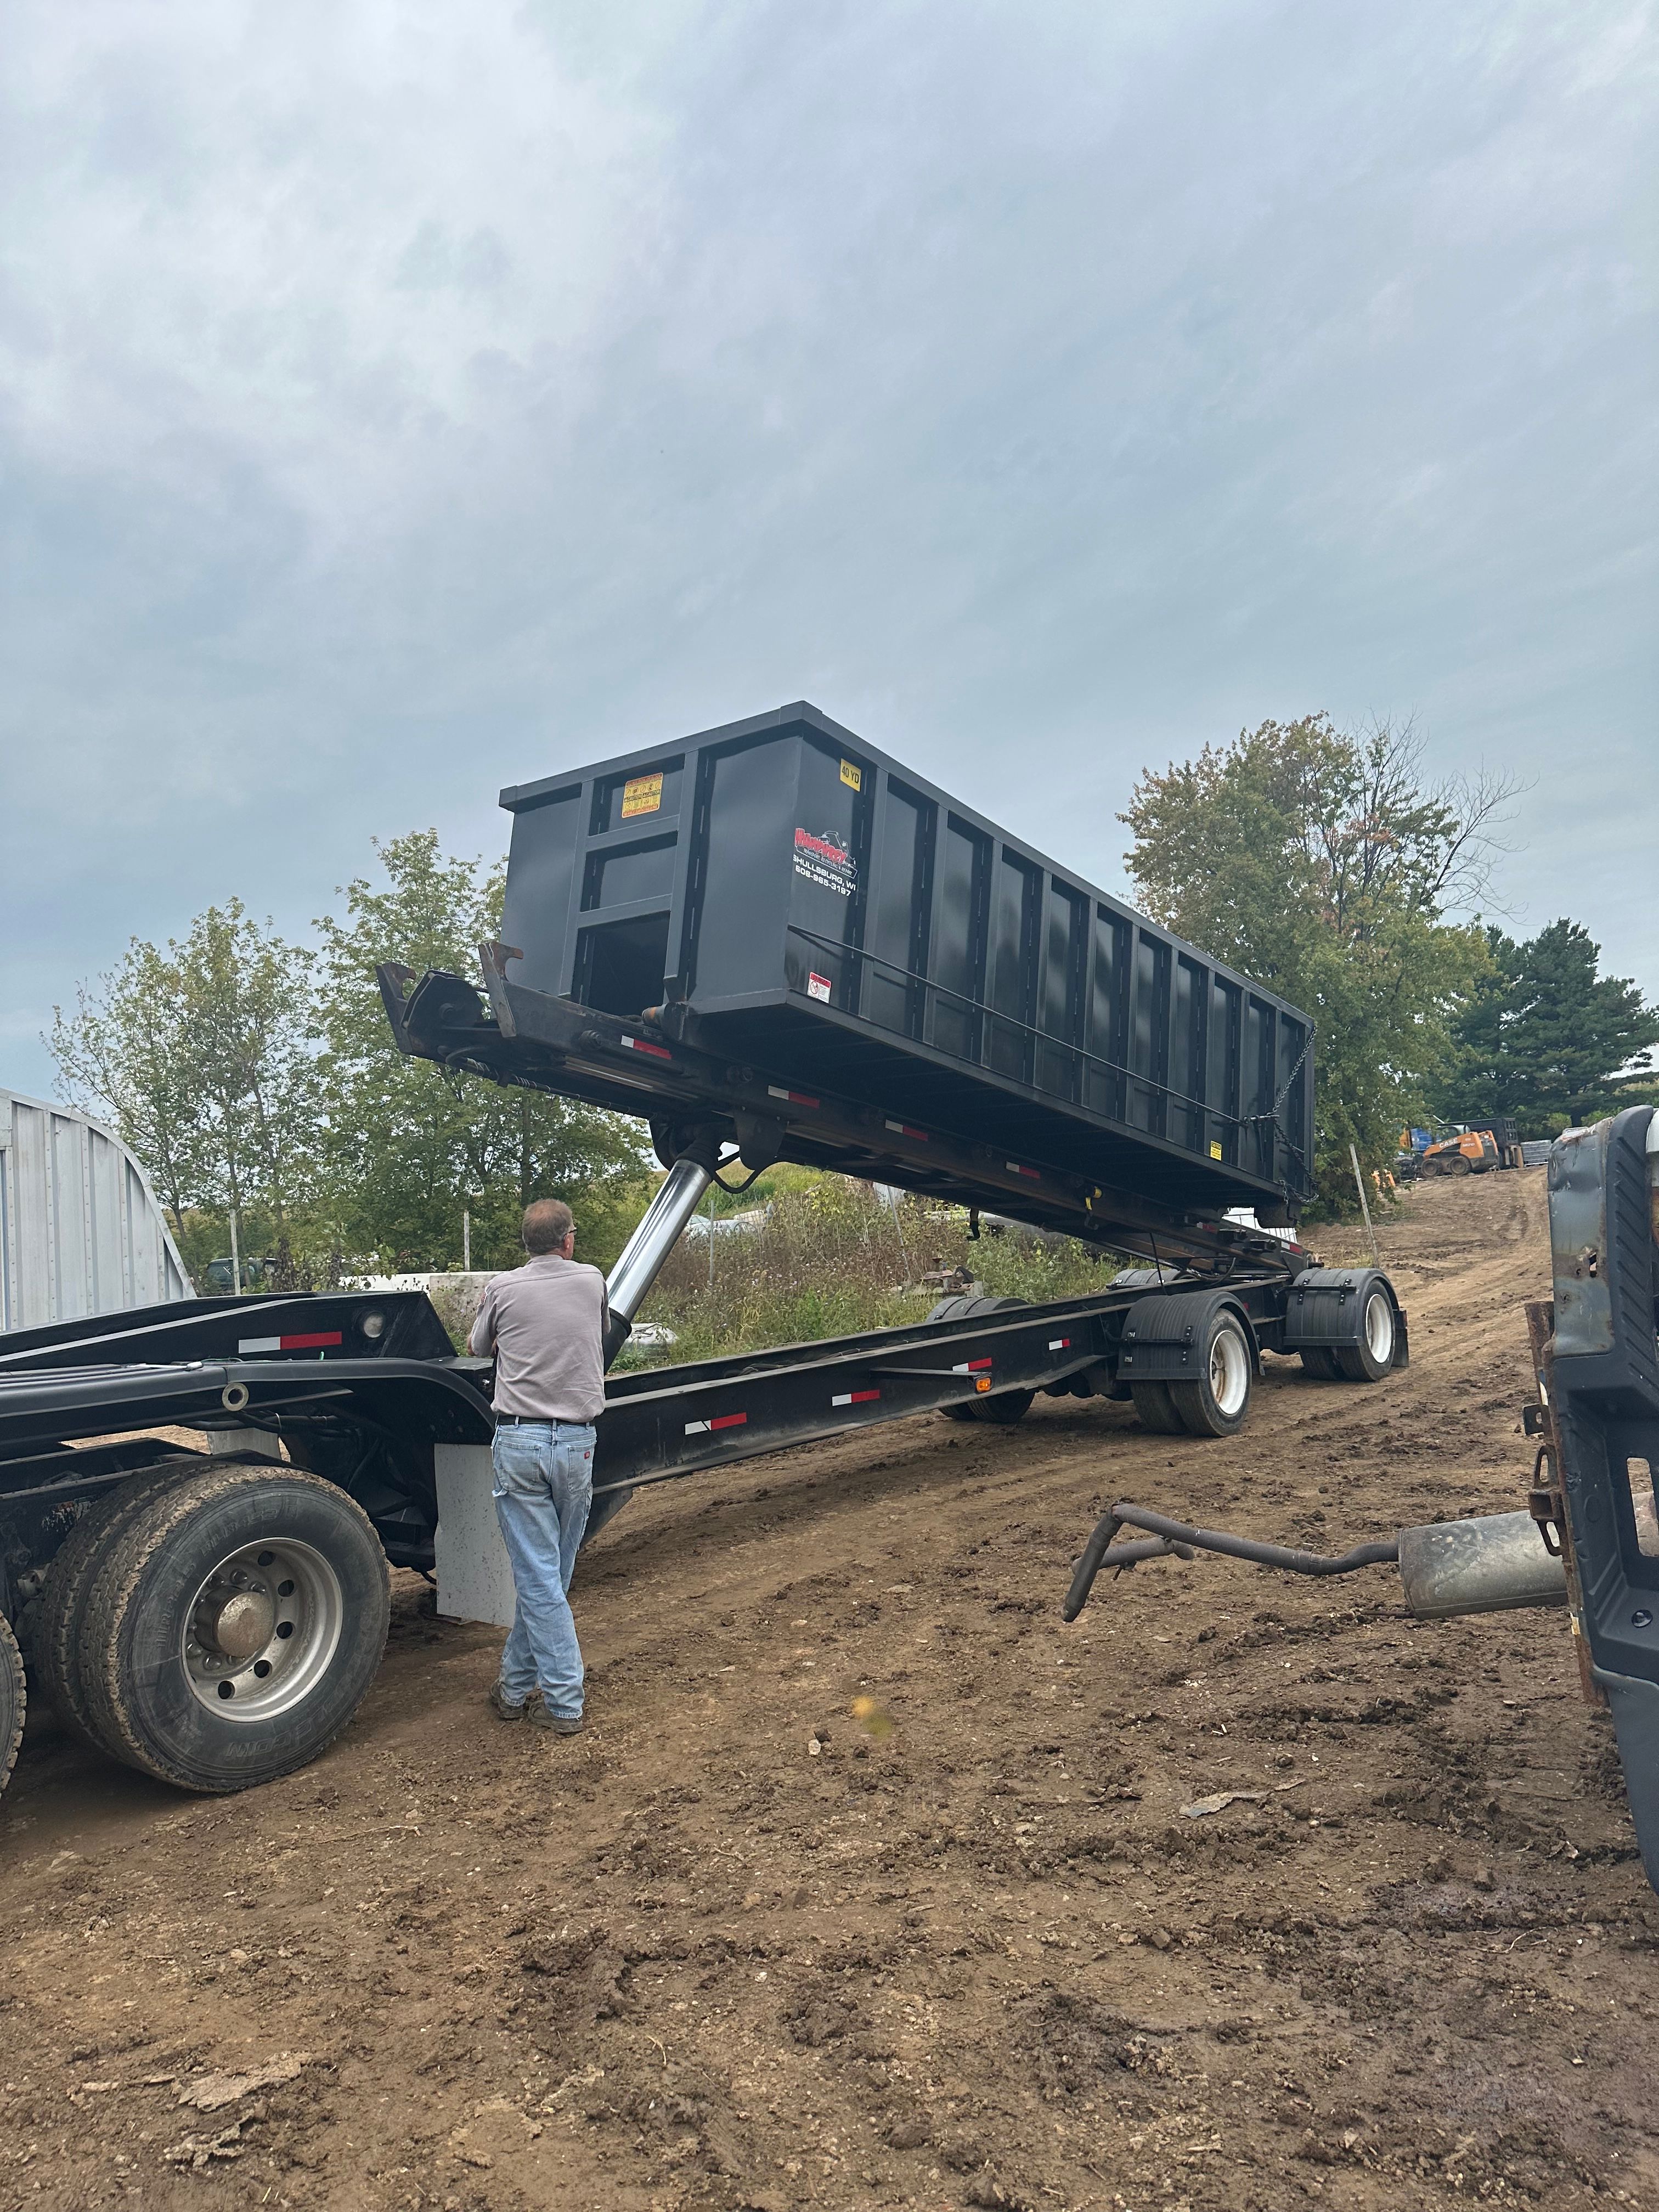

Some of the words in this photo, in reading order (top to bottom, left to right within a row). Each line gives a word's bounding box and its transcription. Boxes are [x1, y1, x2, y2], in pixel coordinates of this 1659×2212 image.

[842, 765, 849, 778] 40
[851, 770, 859, 784] YD
[793, 854, 845, 887] SHULLSBURG,
[846, 880, 856, 891] WI
[795, 865, 852, 896] 608-965-3197
[1439, 1137, 1458, 1148] CASE
